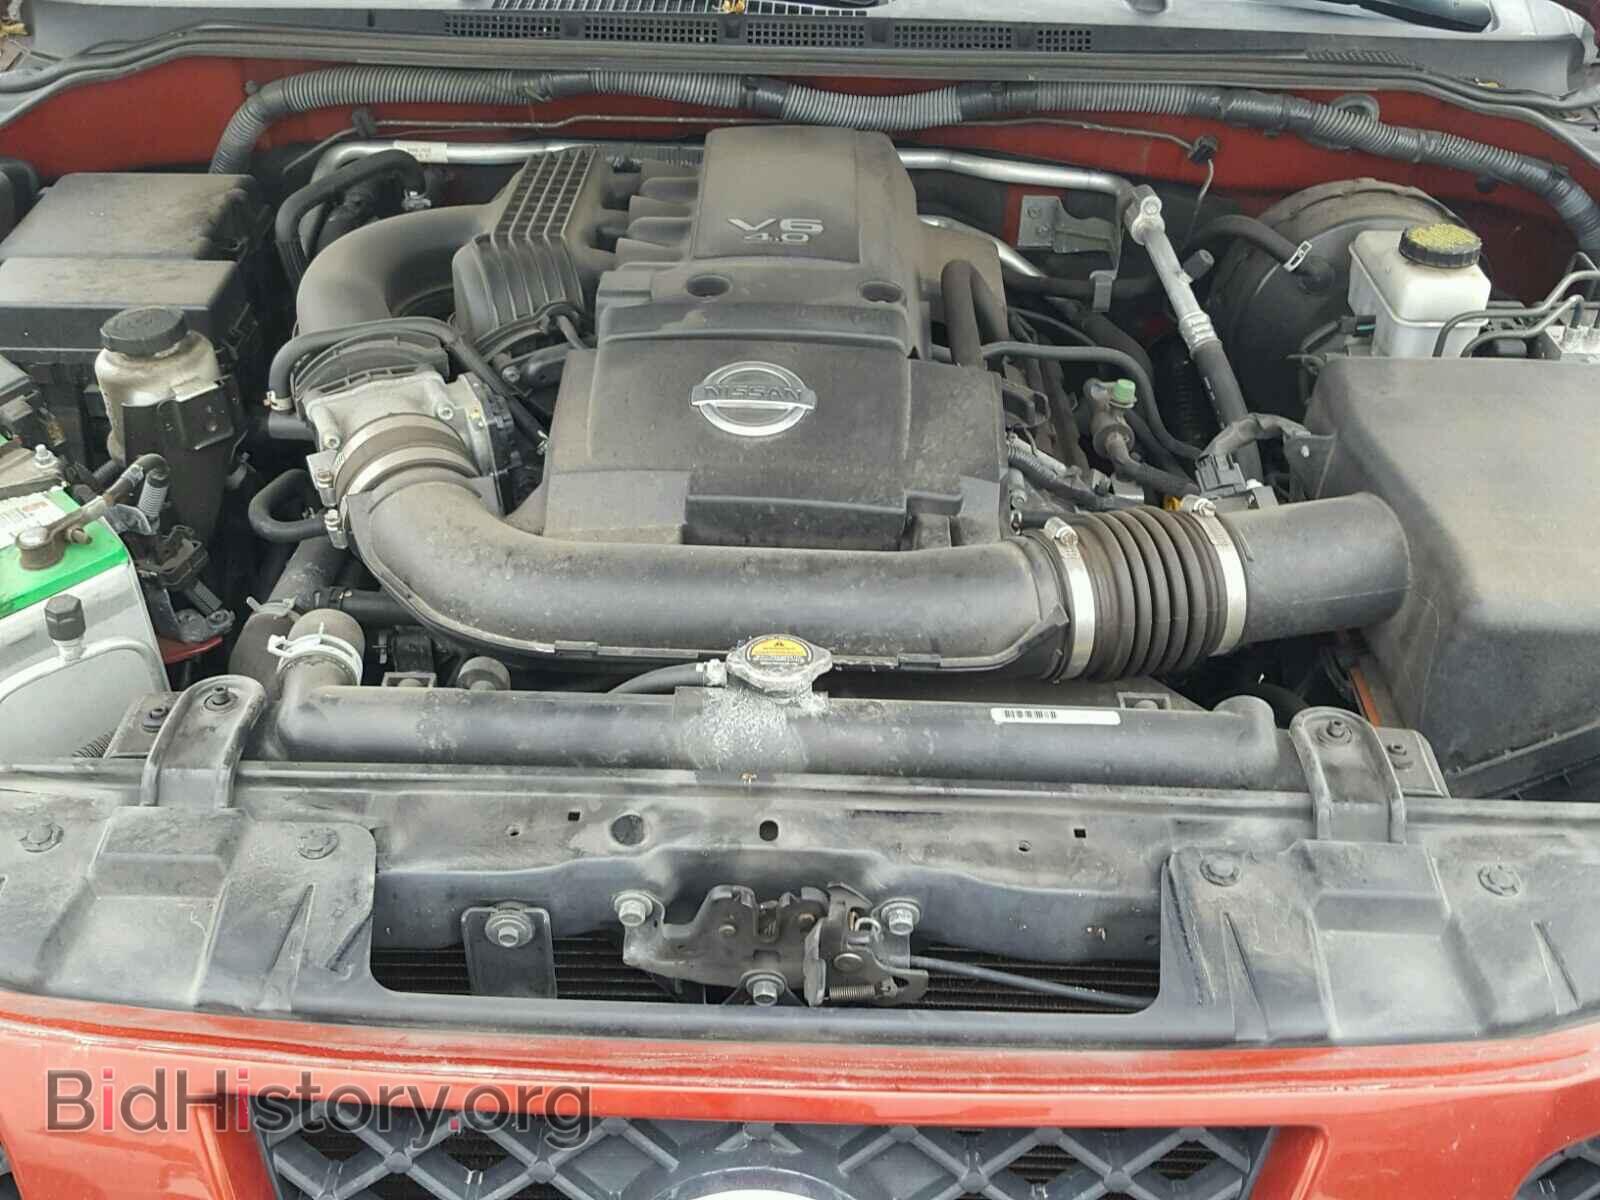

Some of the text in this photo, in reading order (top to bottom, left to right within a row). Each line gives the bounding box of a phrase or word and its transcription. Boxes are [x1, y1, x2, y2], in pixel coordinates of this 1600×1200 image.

[727, 218, 824, 233] V6
[744, 232, 809, 243] 4.0
[704, 385, 802, 401] NISSAN
